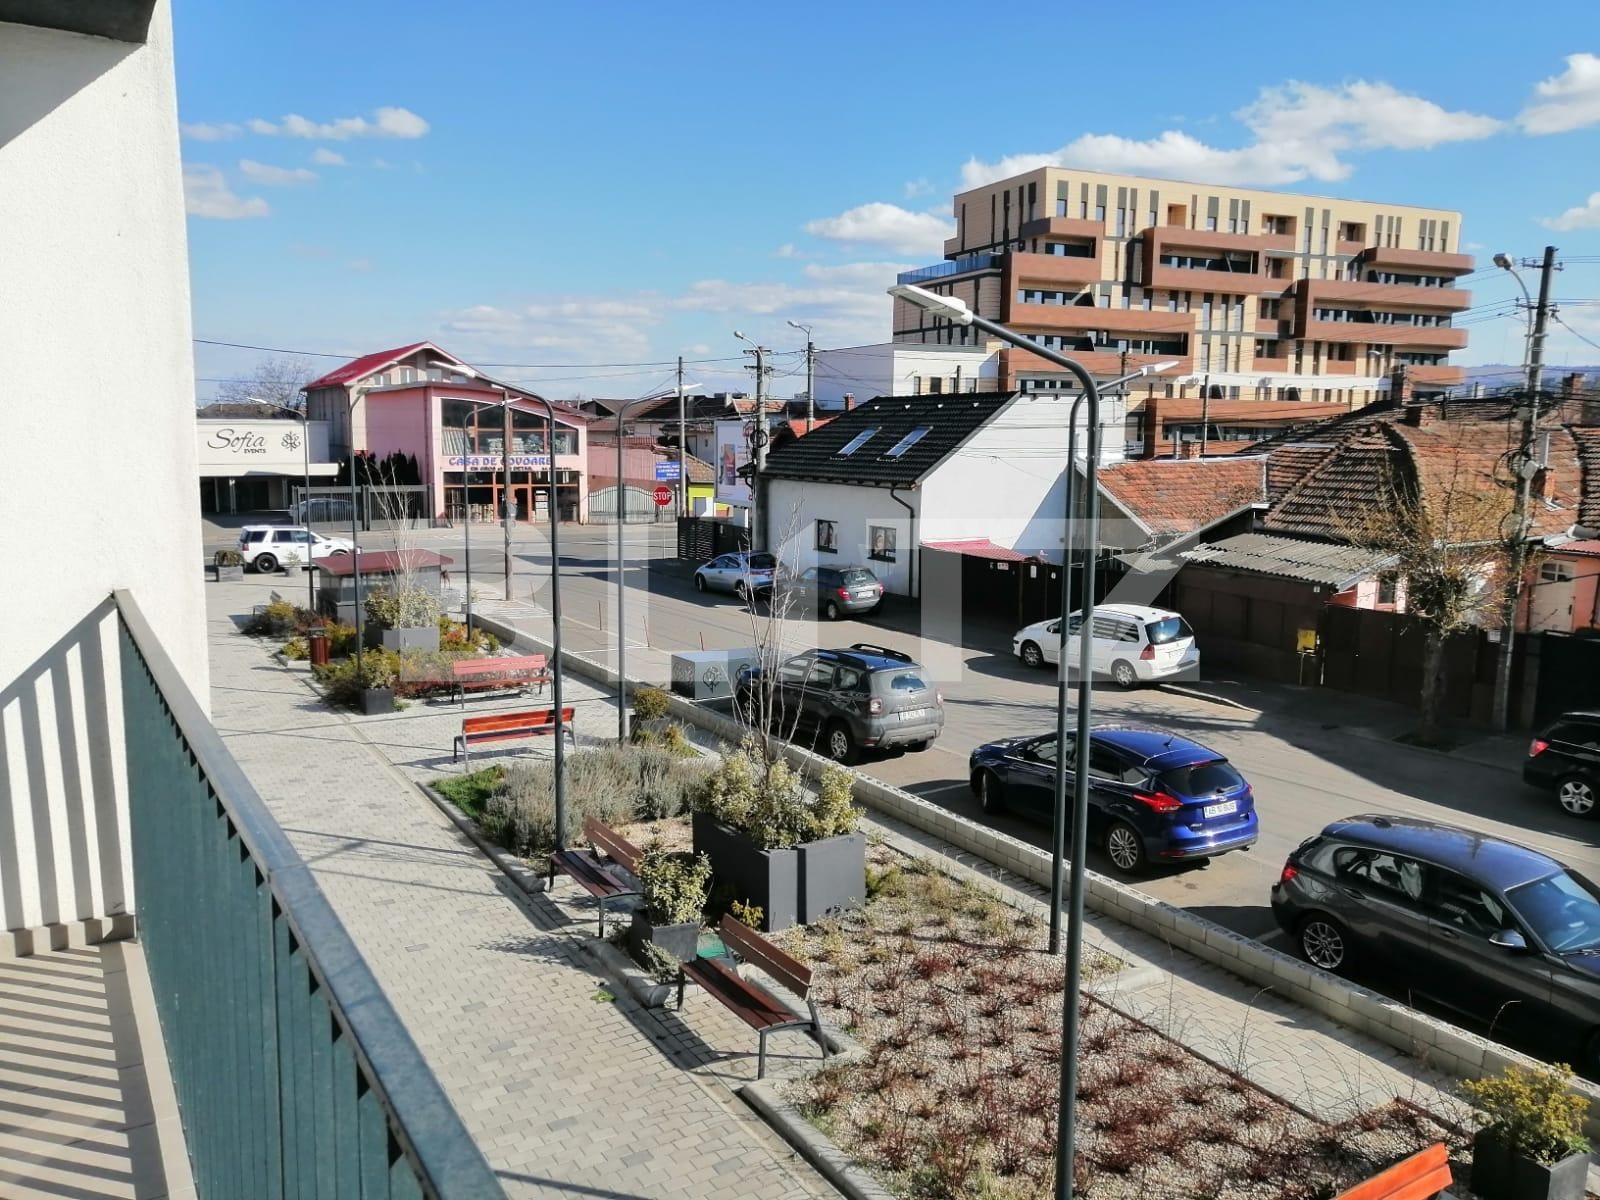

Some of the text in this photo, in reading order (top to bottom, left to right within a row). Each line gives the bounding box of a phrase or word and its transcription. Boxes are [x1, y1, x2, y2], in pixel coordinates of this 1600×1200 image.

[207, 428, 265, 453] Sofia
[448, 456, 479, 466] CASA
[483, 456, 498, 466] DE
[653, 491, 672, 501] STOP
